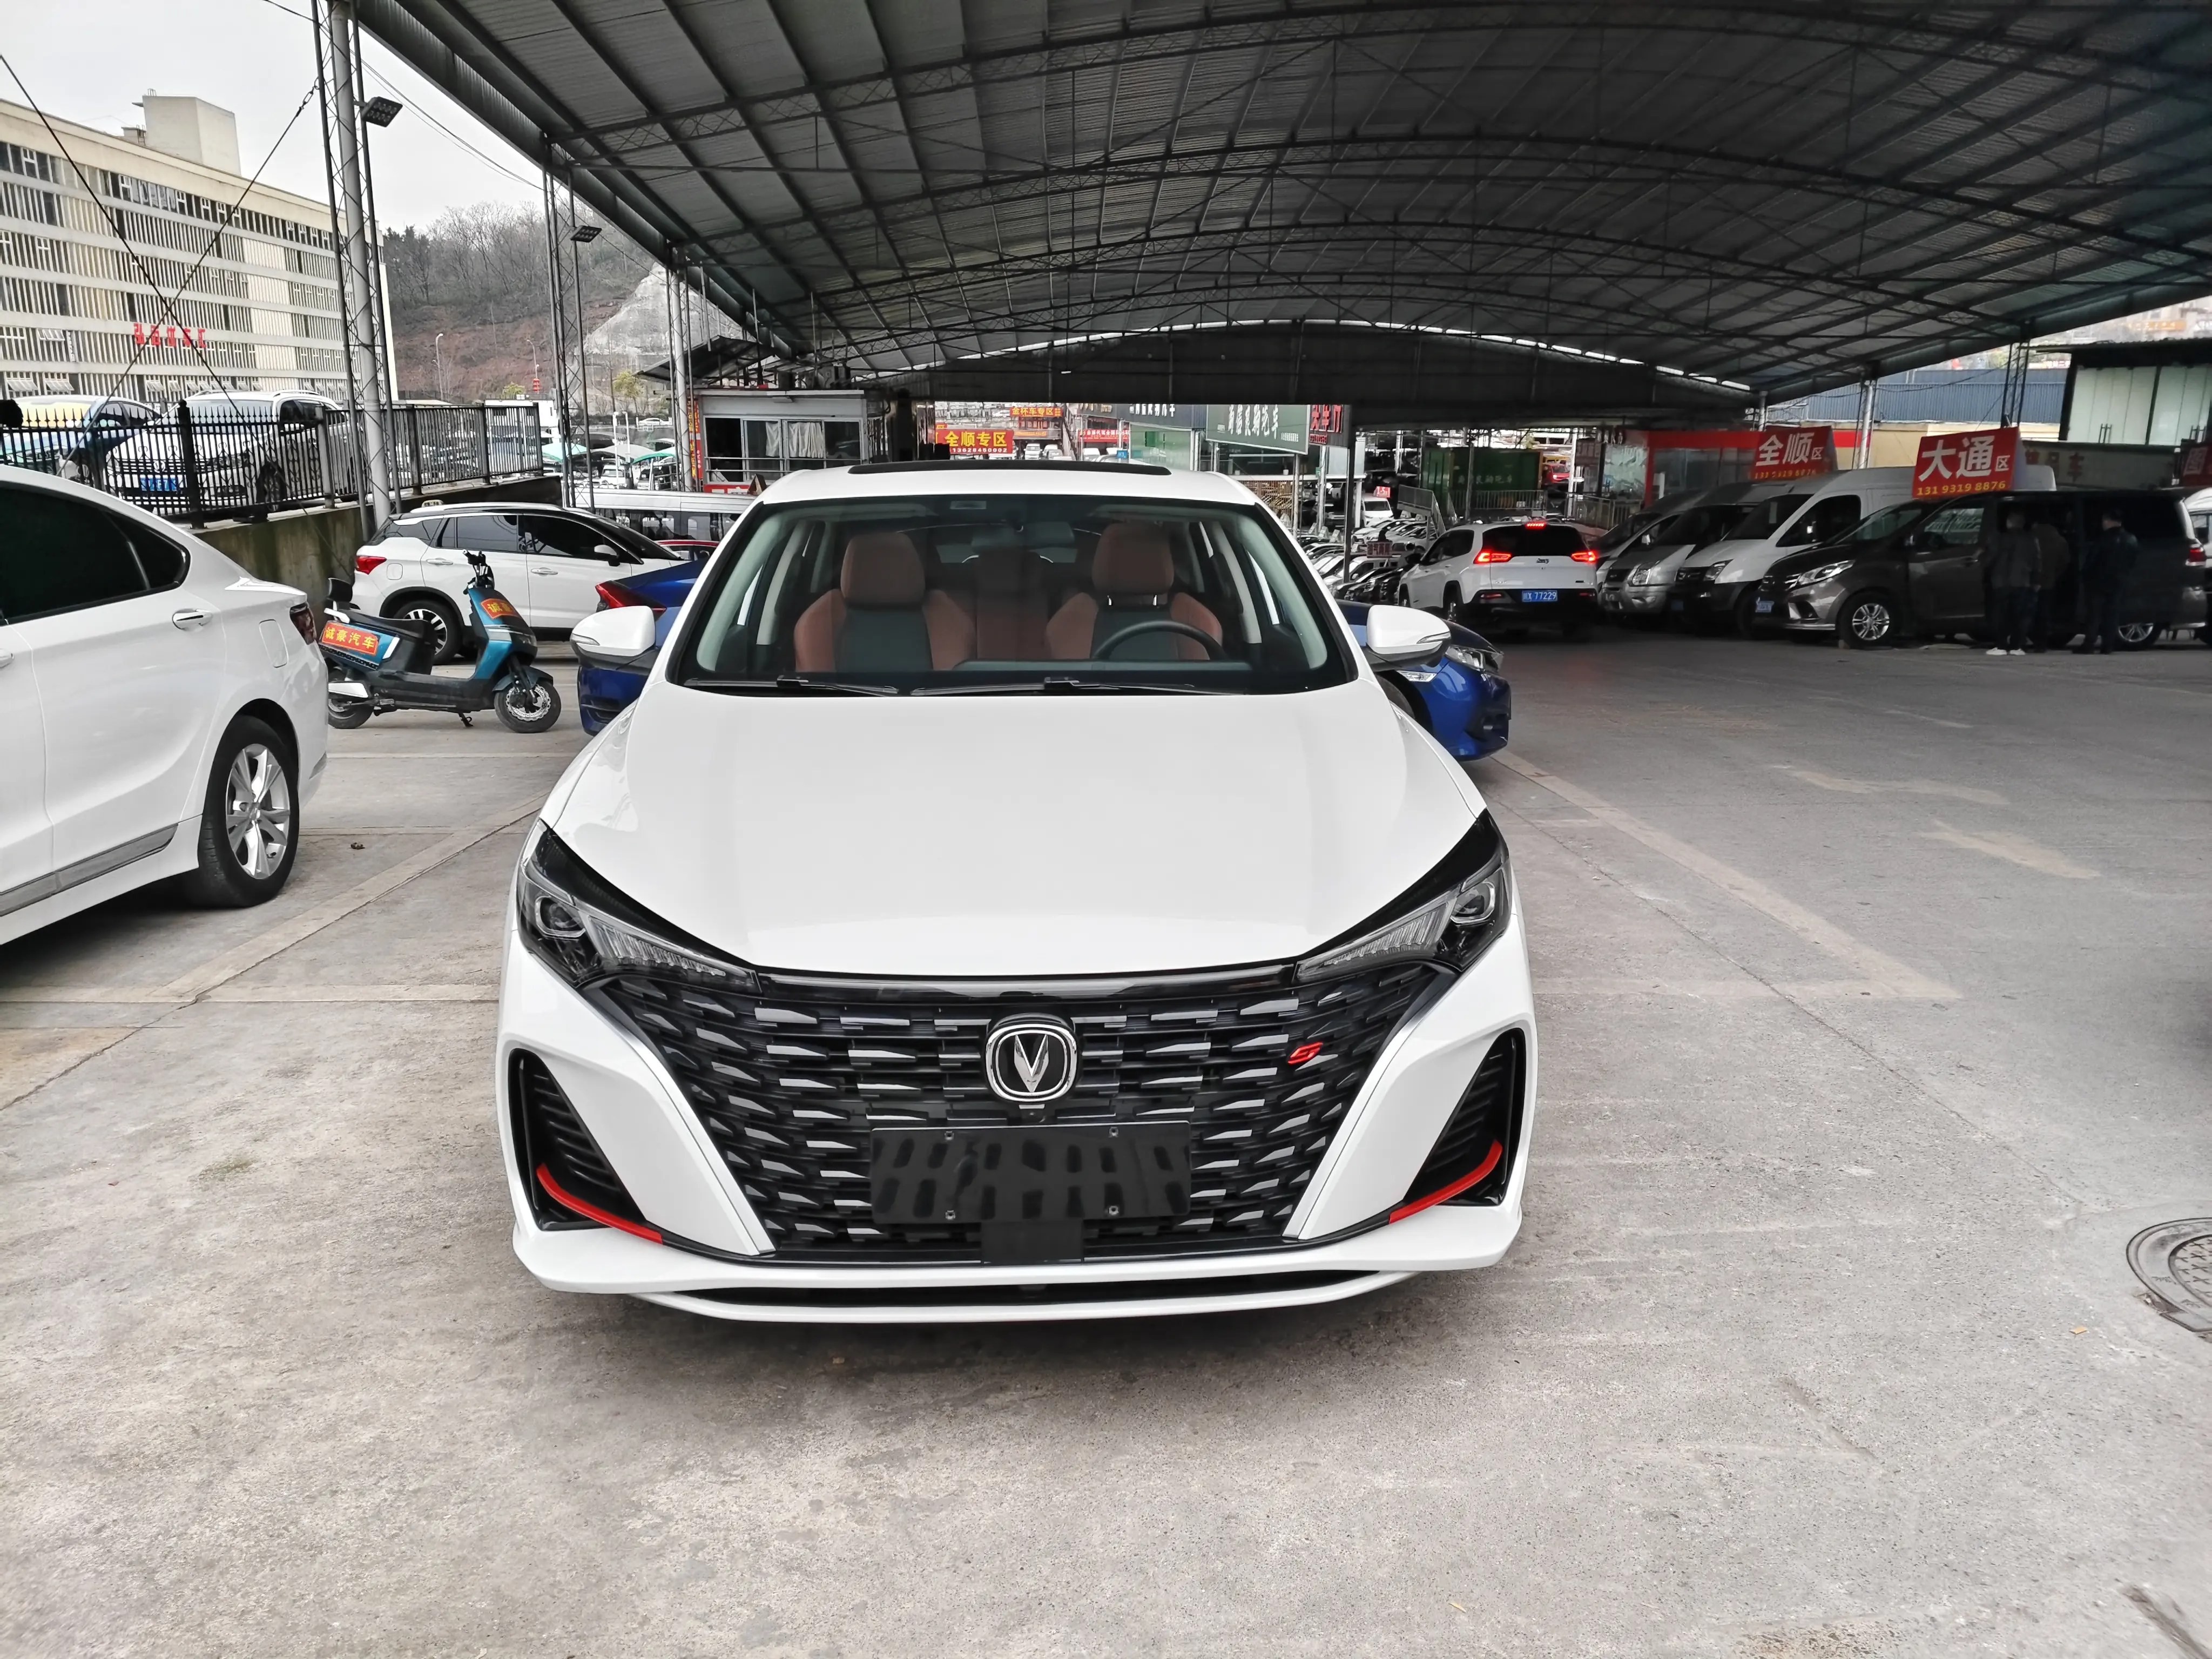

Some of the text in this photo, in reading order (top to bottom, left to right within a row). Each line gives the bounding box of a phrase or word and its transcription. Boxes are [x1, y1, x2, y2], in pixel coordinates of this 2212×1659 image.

[1011, 407, 1054, 416] 金杯车专区
[945, 430, 1007, 447] 全顺专区
[325, 626, 376, 649] 诚豪汽车
